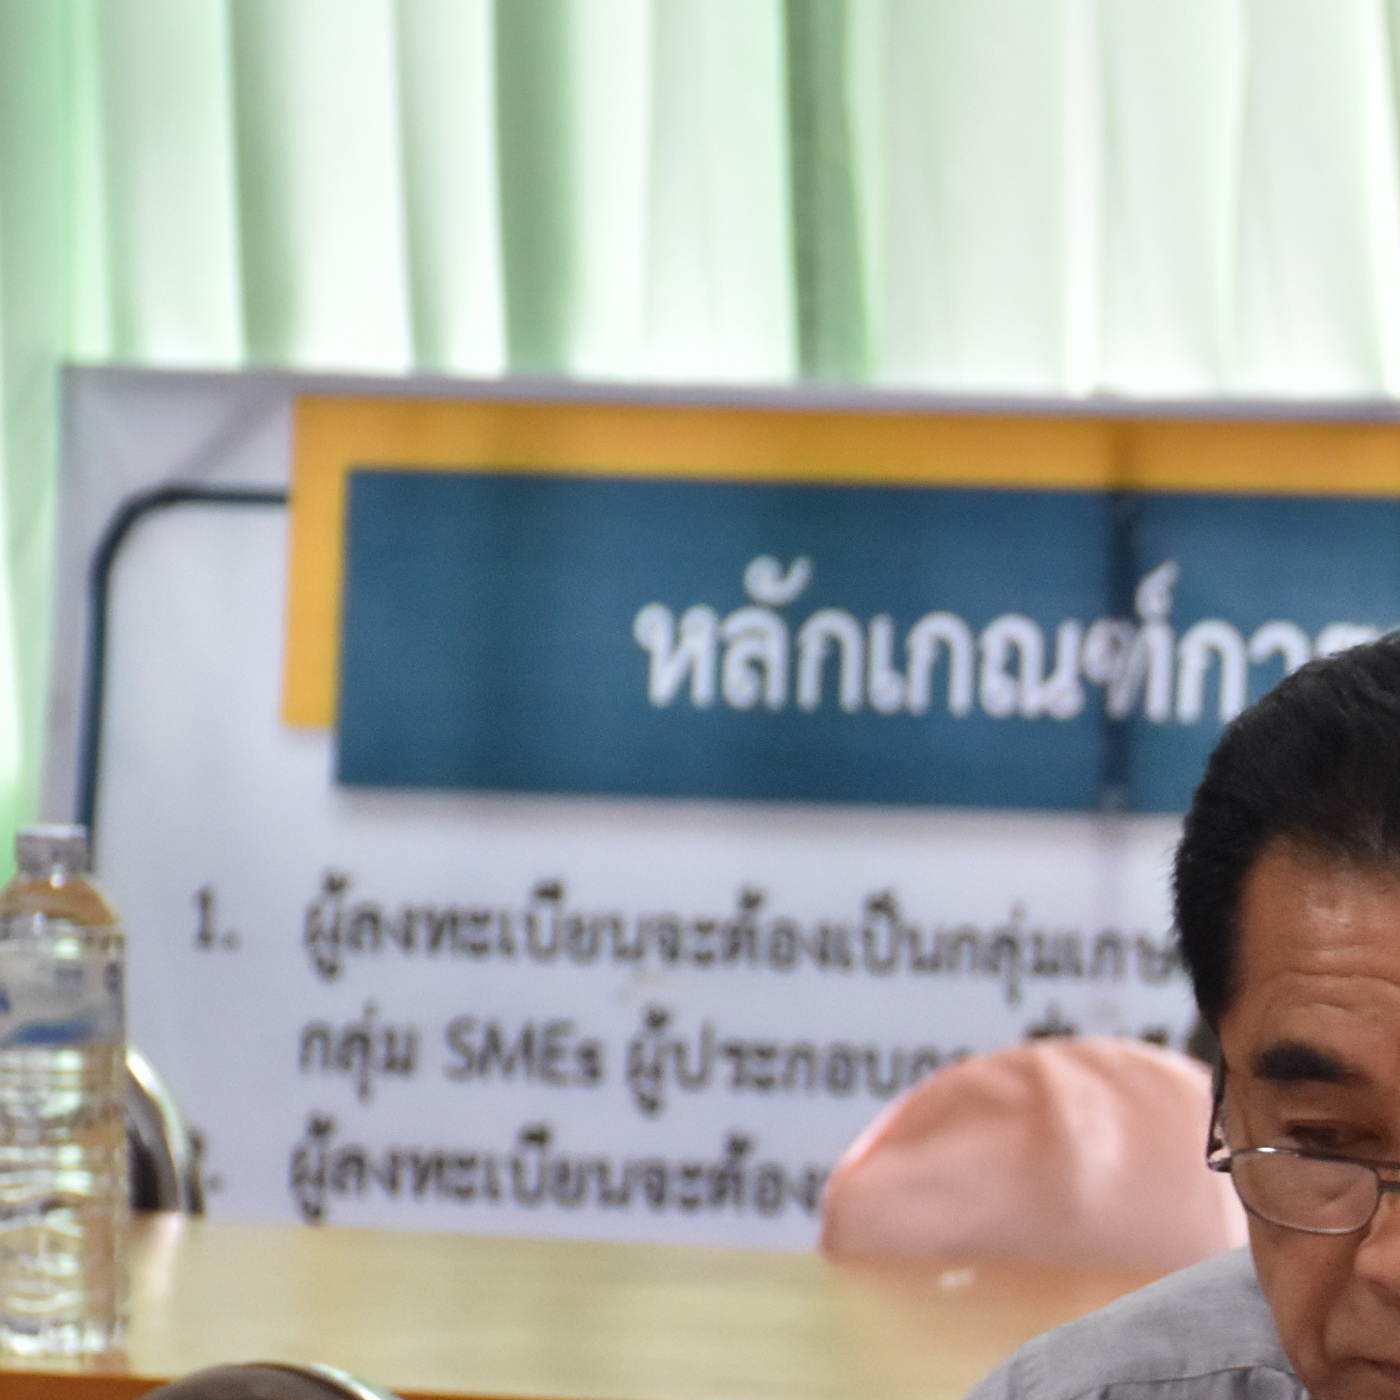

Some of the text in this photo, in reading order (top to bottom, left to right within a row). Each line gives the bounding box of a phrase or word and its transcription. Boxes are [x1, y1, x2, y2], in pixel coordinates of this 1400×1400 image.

[632, 555, 1385, 724] หลักเกณฑ์กา
[194, 886, 238, 948] 1.
[302, 998, 420, 1104] กลุ่ม
[443, 1014, 602, 1088] SMEs
[292, 1112, 830, 1226] ผู้ลงทะเบียนจะต้อง
